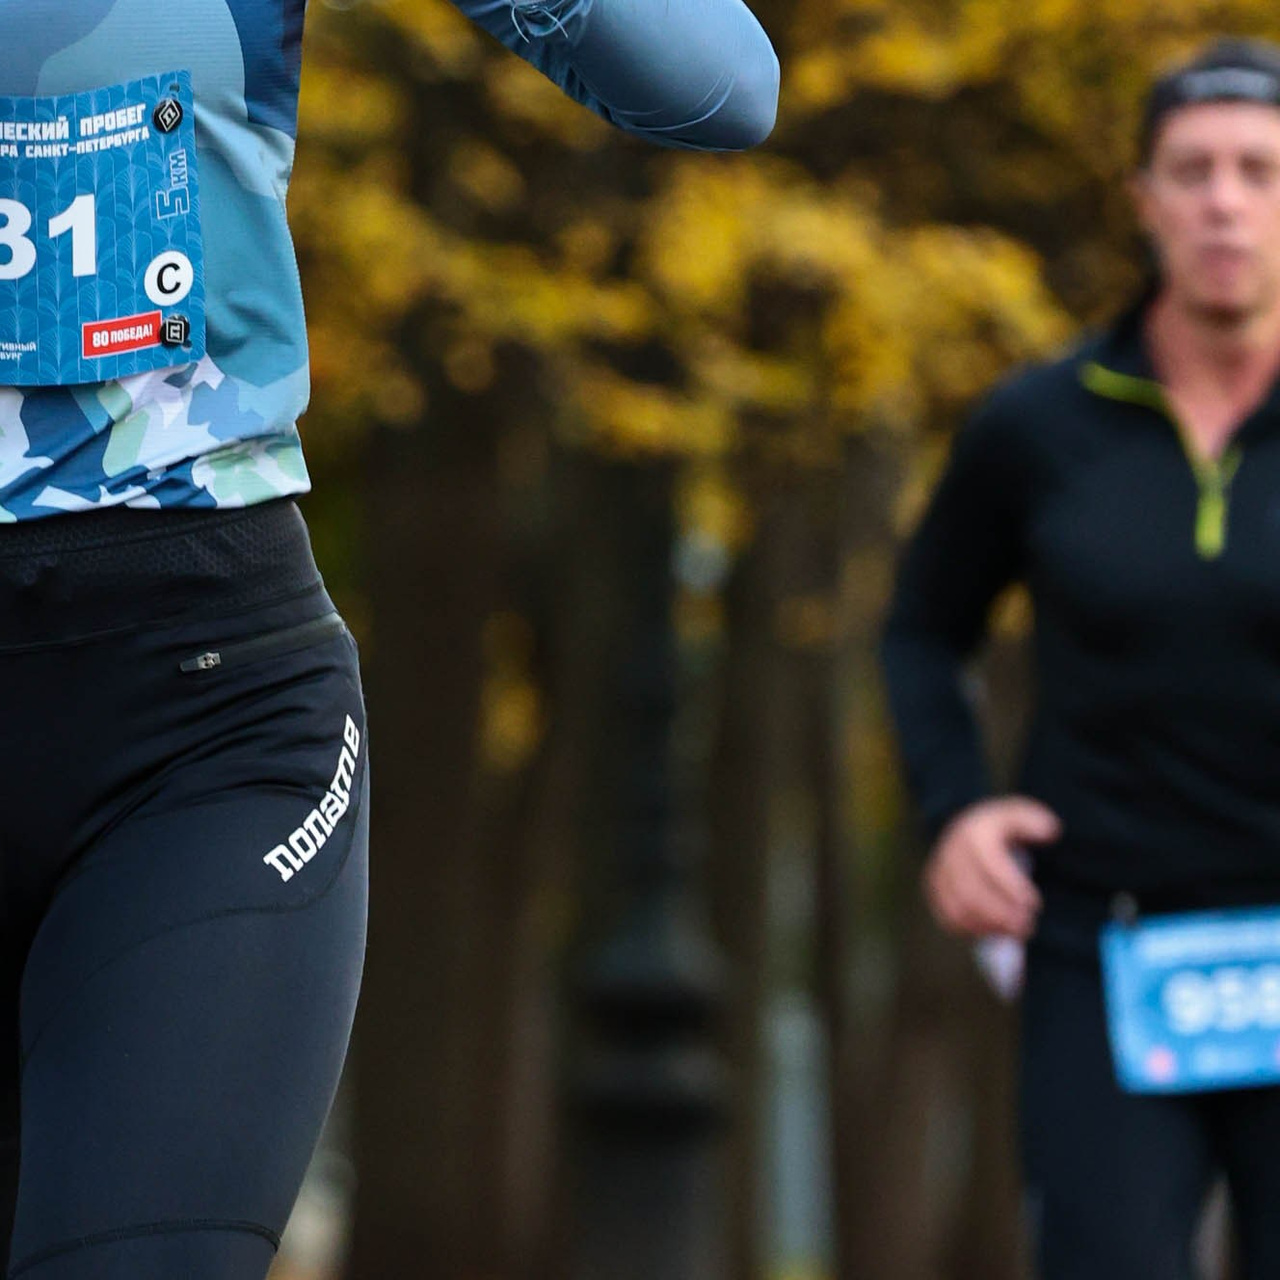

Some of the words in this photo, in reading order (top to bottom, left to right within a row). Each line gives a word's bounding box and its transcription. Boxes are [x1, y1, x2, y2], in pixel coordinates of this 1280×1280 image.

[80, 103, 146, 137] ПРОБЕГ
[25, 125, 150, 158] САНКТ-ПЕТЕРБУРГА
[92, 330, 110, 348] 80
[110, 323, 153, 344] ПОБЕДА!
[263, 714, 360, 883] noname
